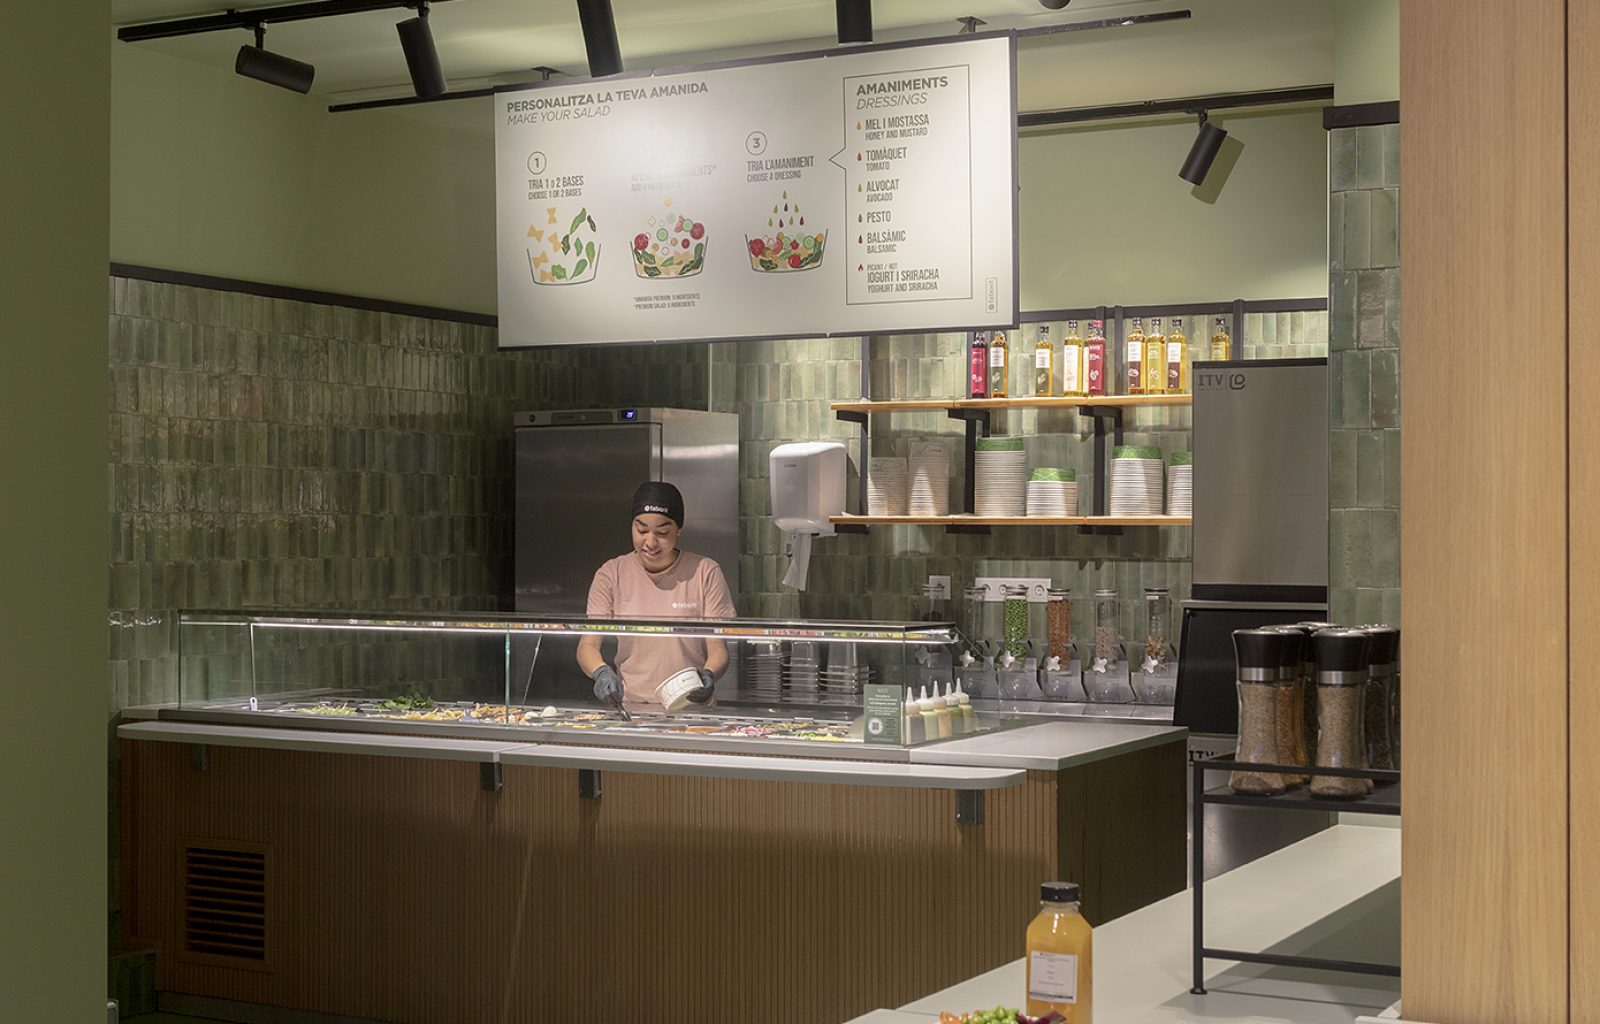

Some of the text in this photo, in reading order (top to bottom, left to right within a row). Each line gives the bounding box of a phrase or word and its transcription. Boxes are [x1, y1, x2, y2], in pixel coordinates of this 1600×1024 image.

[856, 76, 948, 96] AMANIMENTS
[507, 82, 709, 112] PERSONALITZA LA TEVA AMANIDA
[856, 92, 928, 110] DRESSINGS
[507, 105, 611, 125] MAKE YOUR SALAD
[865, 114, 929, 130] MEL I MOSTASSA
[865, 127, 928, 141] HONEY AND MUSTARD
[752, 137, 761, 149] 3
[866, 146, 907, 161] TOMÀQUET
[746, 160, 764, 172] TRIA
[866, 161, 890, 172] TOMATO
[528, 178, 543, 190] TRIA
[545, 178, 549, 189] 1
[556, 177, 561, 188] 2
[562, 175, 585, 187] BASES
[746, 170, 802, 183] CHOOSE A DRESSING
[866, 178, 900, 192] ALVOCAT
[528, 190, 548, 200] CHOOSE
[553, 190, 560, 198] OR
[561, 189, 565, 198] 2
[565, 188, 582, 197] BASES
[866, 192, 893, 202] AVOCADO
[866, 210, 892, 223] PESTO
[867, 229, 906, 244] BALSÀMIC
[867, 243, 897, 254] BALSAMIC
[867, 271, 894, 283] IOGURT
[901, 268, 939, 281] SRIRACHA
[867, 281, 938, 293] YOGHURT AND SRIRACHA
[1198, 374, 1224, 386] ITV
